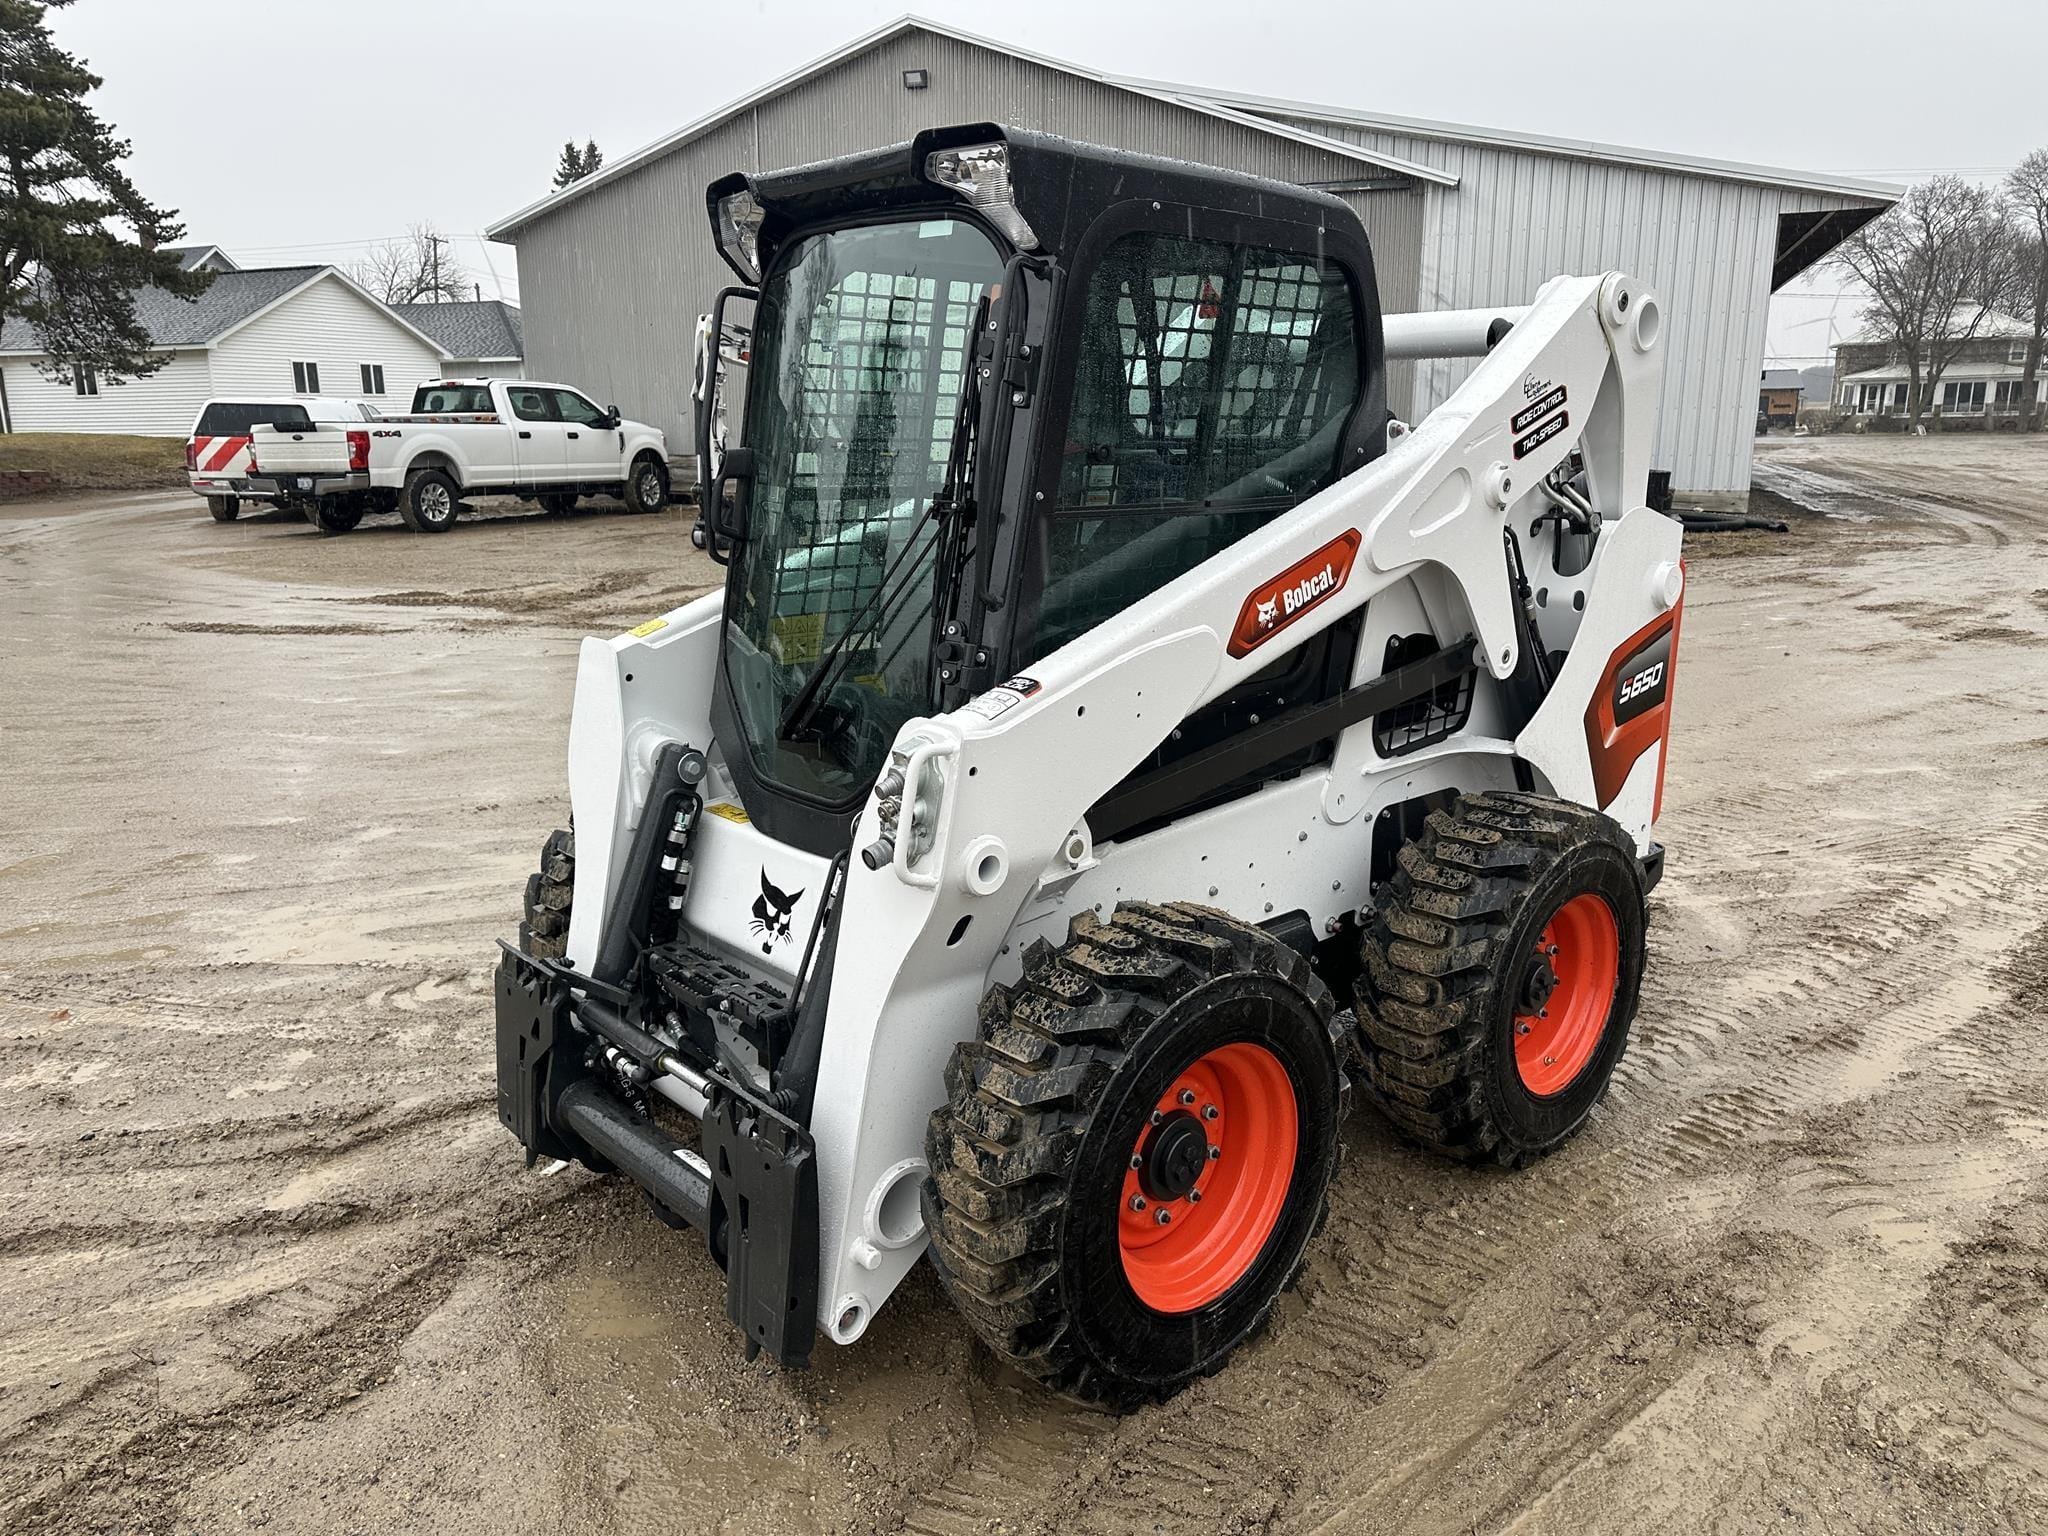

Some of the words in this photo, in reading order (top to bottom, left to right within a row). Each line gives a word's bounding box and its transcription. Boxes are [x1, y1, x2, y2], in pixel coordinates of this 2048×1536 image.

[1516, 411, 1534, 430] RIDE
[1533, 391, 1564, 418] CONTROL
[1522, 417, 1563, 452] TWO-SPEED
[1282, 563, 1335, 615] Bobcat
[1619, 661, 1664, 705] S650
